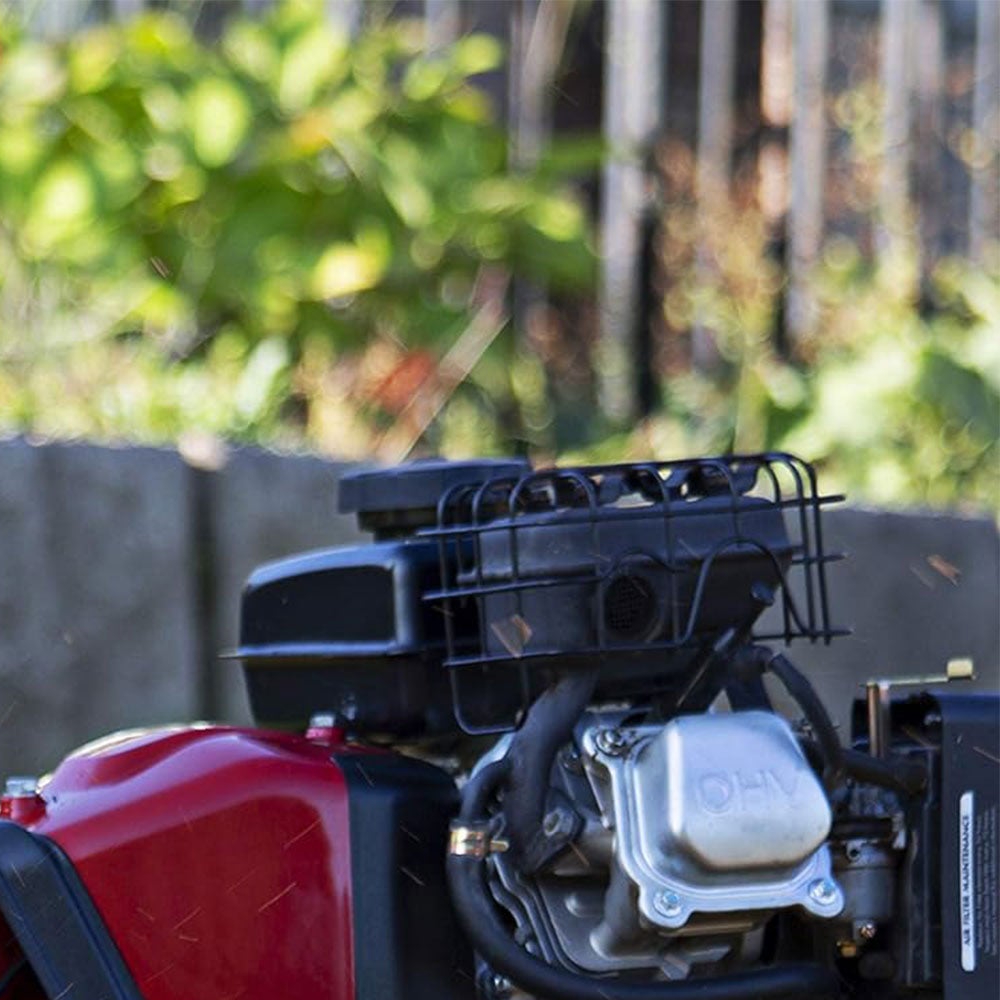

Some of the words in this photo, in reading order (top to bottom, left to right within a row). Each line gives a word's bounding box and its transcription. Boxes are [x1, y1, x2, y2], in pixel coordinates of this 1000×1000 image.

[699, 769, 799, 815] OHV
[962, 815, 970, 892] MAINTENANCE
[962, 895, 970, 926] FILTER
[963, 929, 971, 946] AIR
